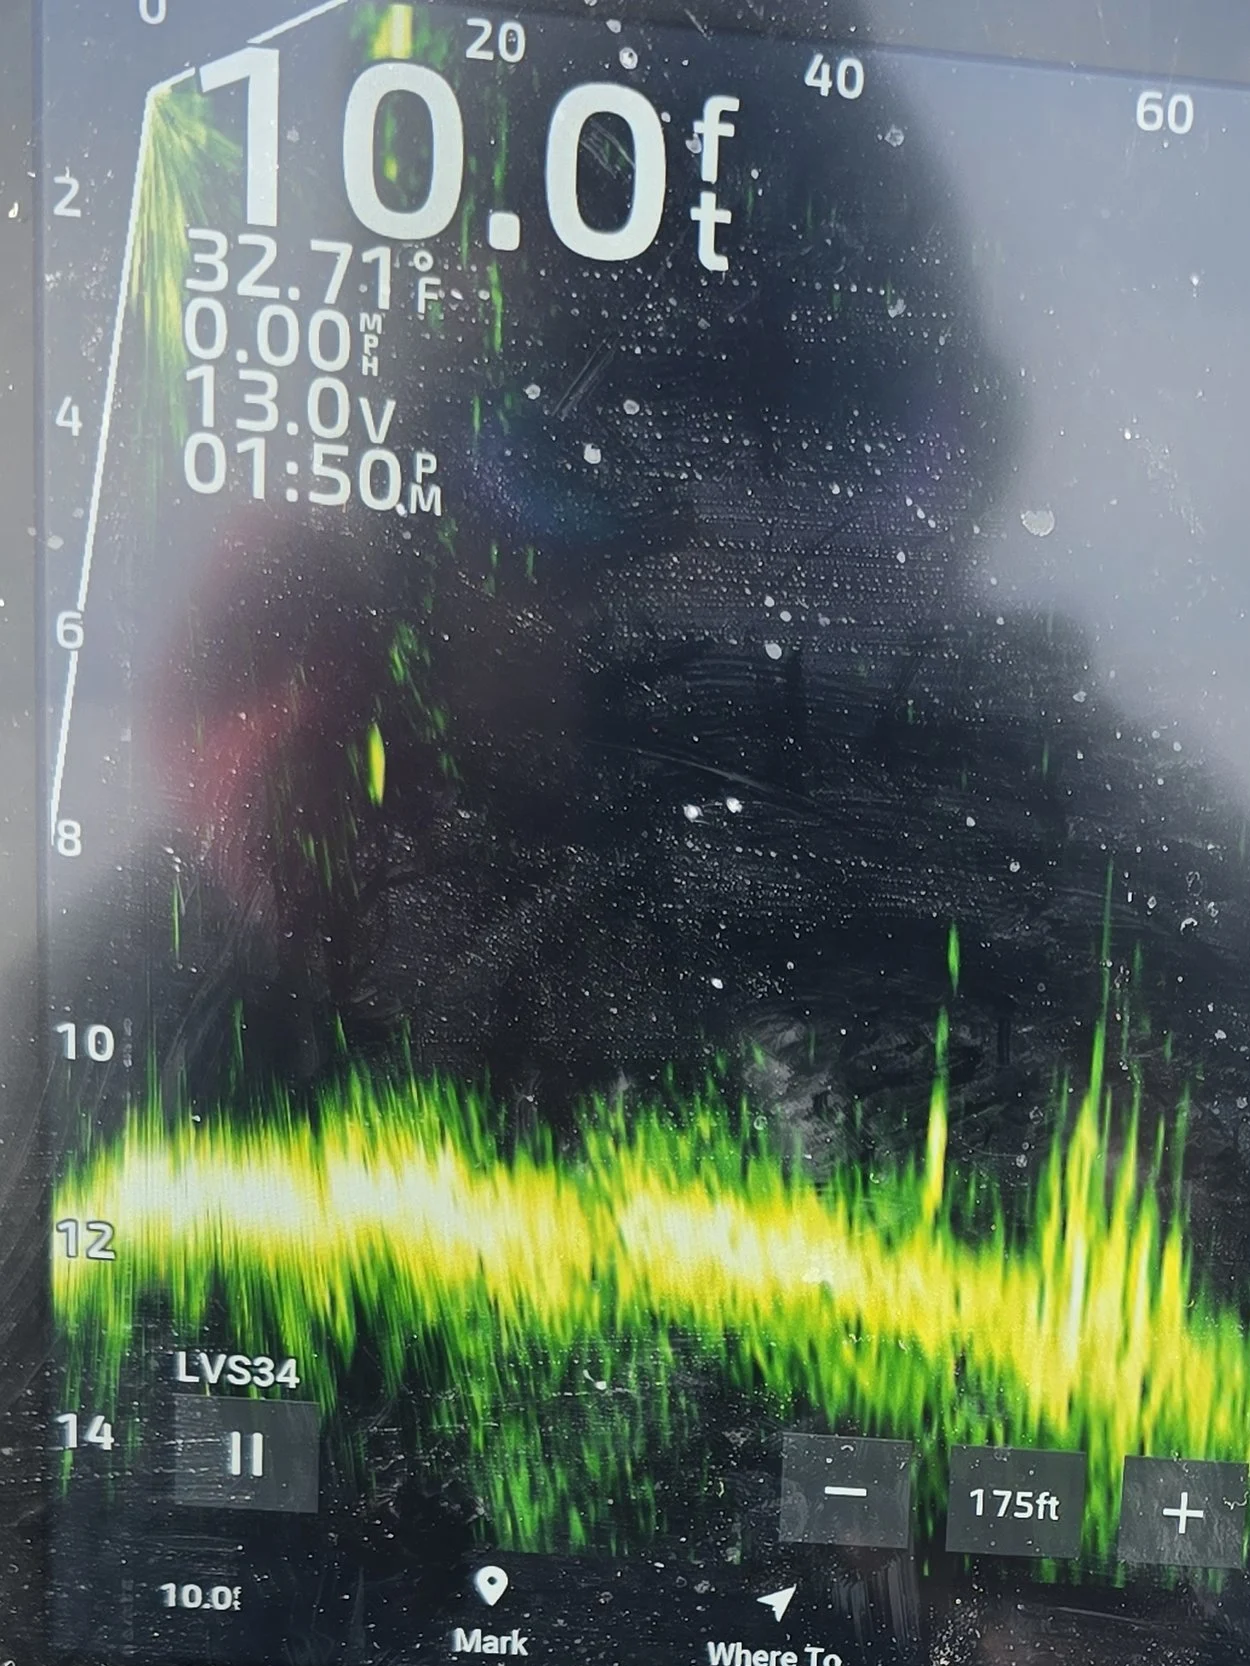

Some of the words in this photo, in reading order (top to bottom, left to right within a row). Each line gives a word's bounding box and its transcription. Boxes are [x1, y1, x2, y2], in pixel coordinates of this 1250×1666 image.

[465, 18, 527, 63] 20
[803, 53, 866, 100] 40
[1134, 91, 1195, 135] 60
[199, 46, 667, 262] 10.0
[52, 177, 82, 219] 2
[185, 228, 391, 310] 32.71
[184, 297, 351, 372] 0.00
[56, 397, 82, 437] 4
[184, 432, 402, 511] 01:50
[55, 610, 84, 650] 6
[55, 819, 83, 858] 8
[55, 1022, 115, 1062] 10
[55, 1218, 117, 1261] 12
[177, 1350, 300, 1389] LVS34
[55, 1412, 115, 1451] 14
[968, 1487, 1062, 1523] 175ft
[453, 1627, 529, 1657] Mark
